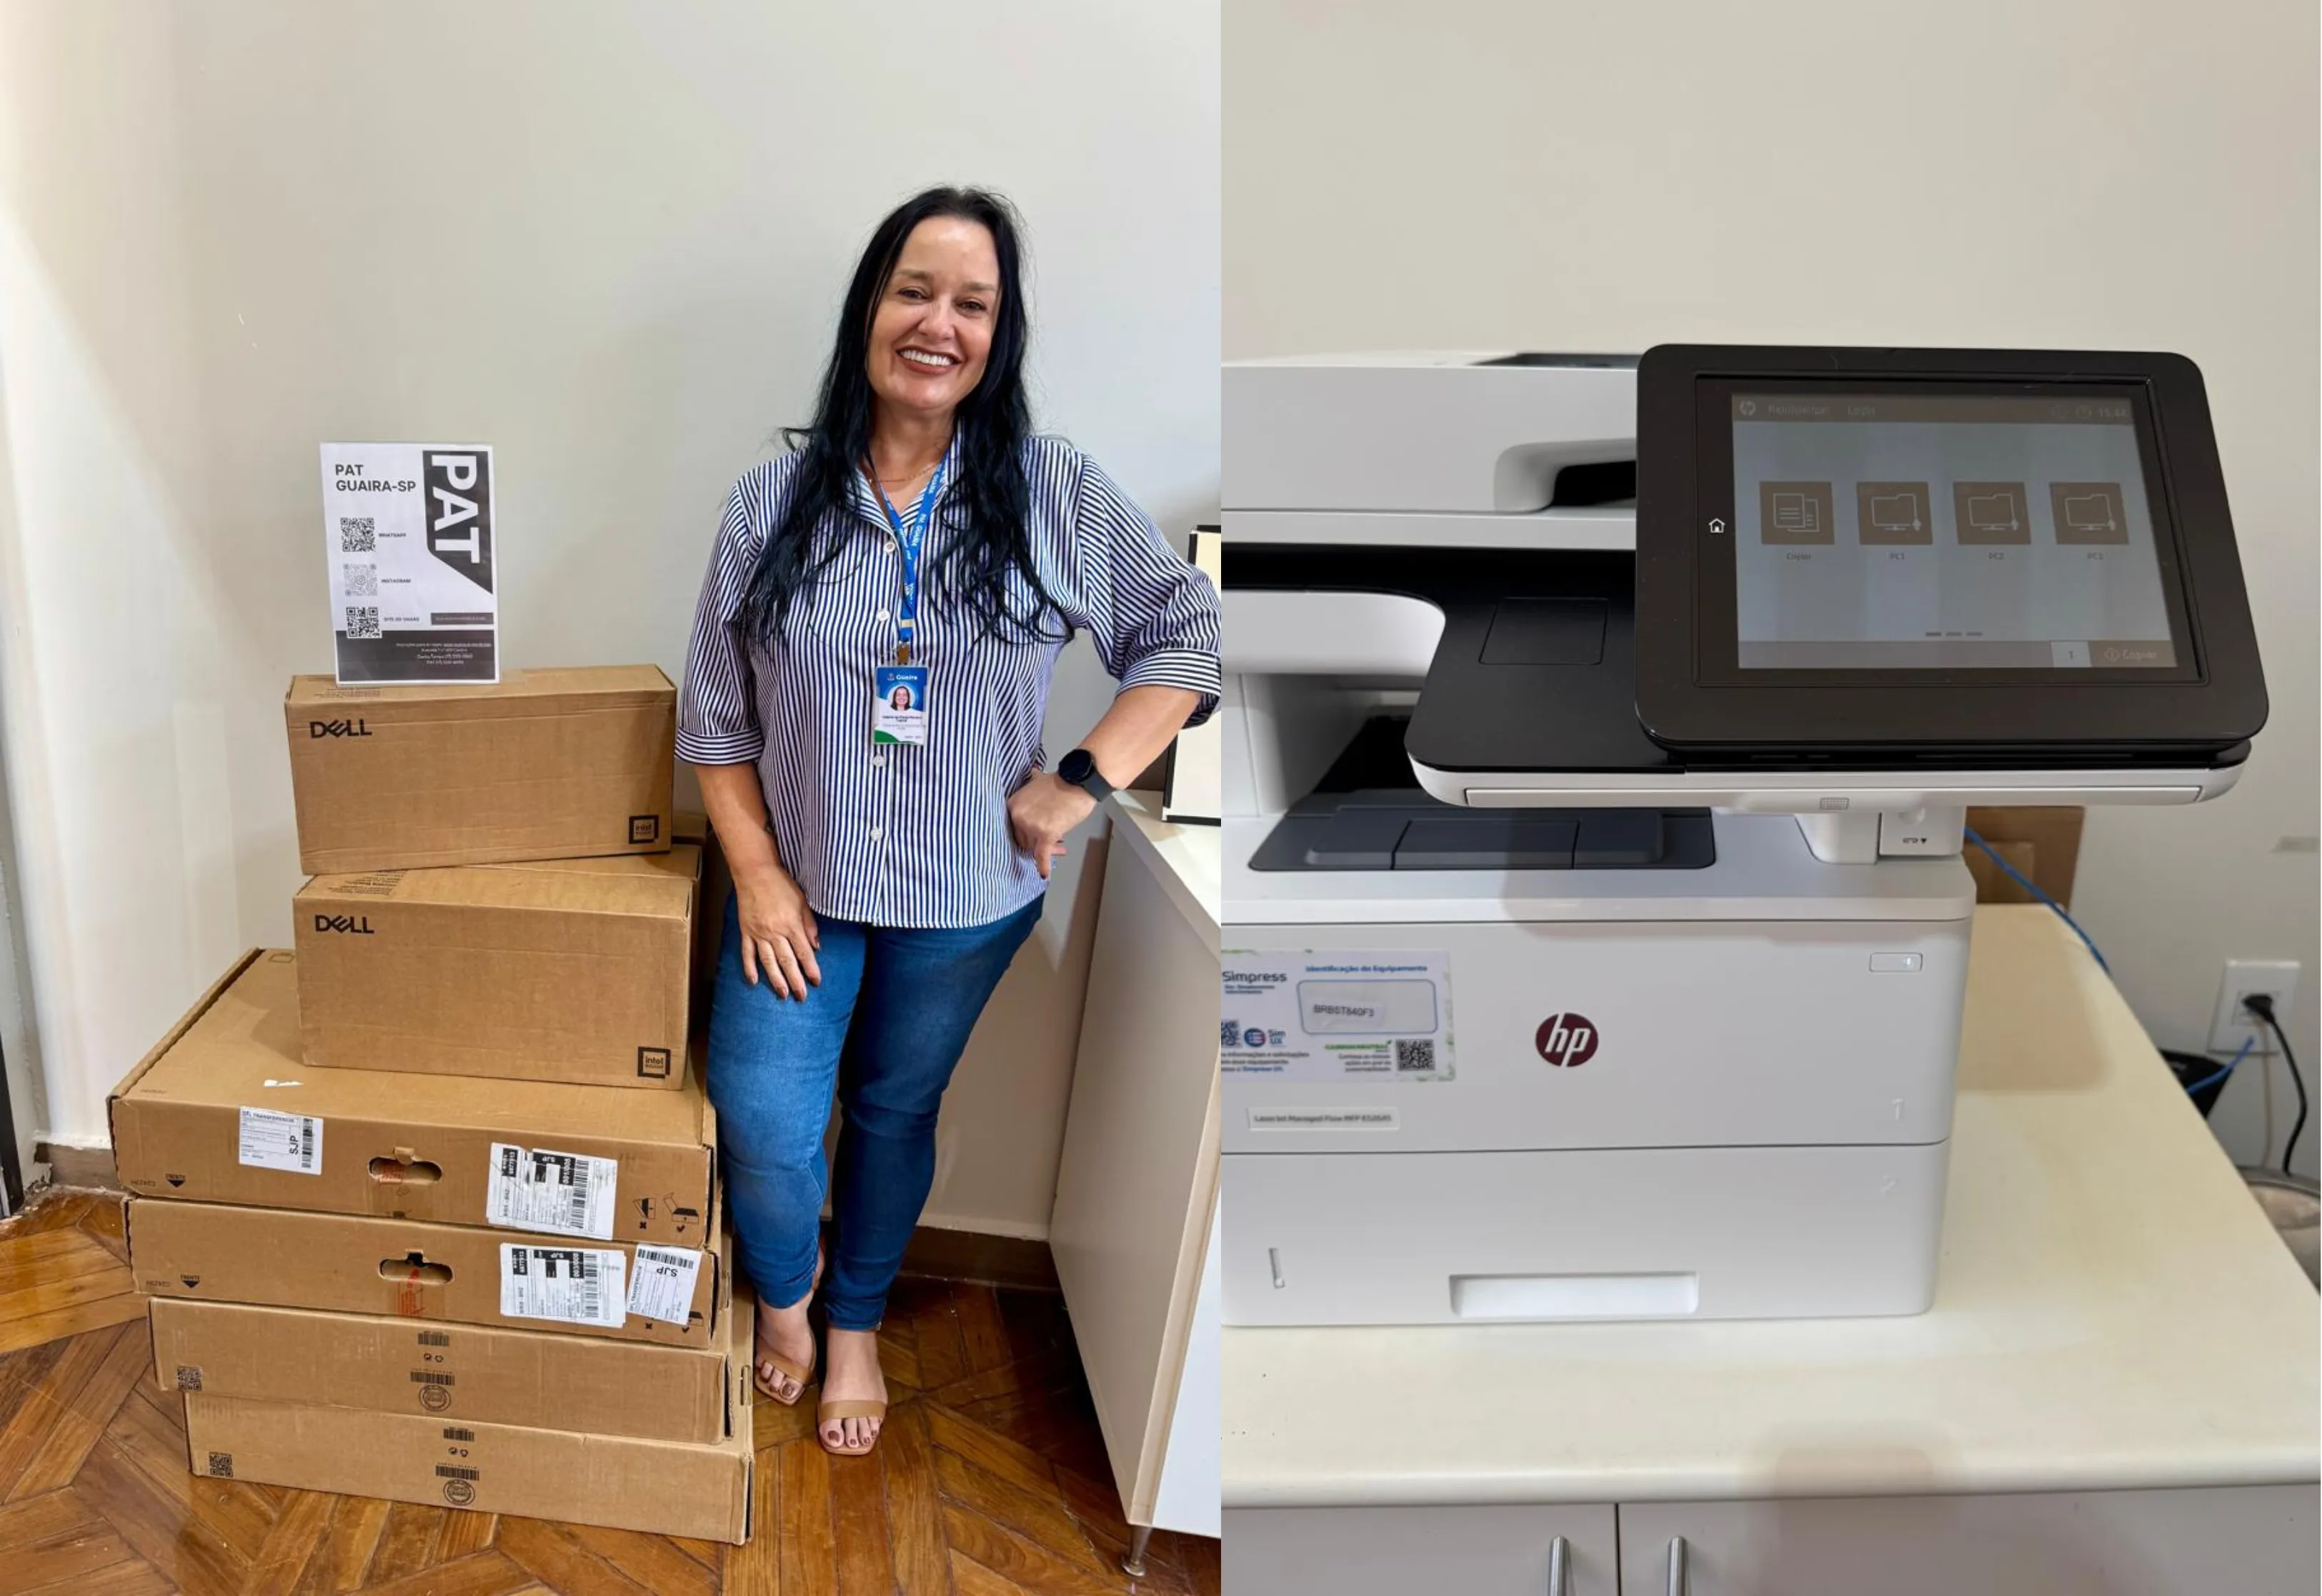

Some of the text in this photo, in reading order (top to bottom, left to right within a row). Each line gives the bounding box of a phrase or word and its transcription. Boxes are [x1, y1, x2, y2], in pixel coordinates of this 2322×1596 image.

[335, 464, 364, 476] PAT
[336, 480, 416, 492] GUAIRA-SP
[432, 454, 480, 564] PAT
[309, 719, 372, 739] DELL
[315, 914, 374, 934] DELL
[1222, 970, 1287, 984] Simpress
[1544, 1013, 1592, 1067] hp
[645, 1055, 664, 1065] intel
[289, 1134, 299, 1155] SJP
[656, 1266, 678, 1277] SJP
